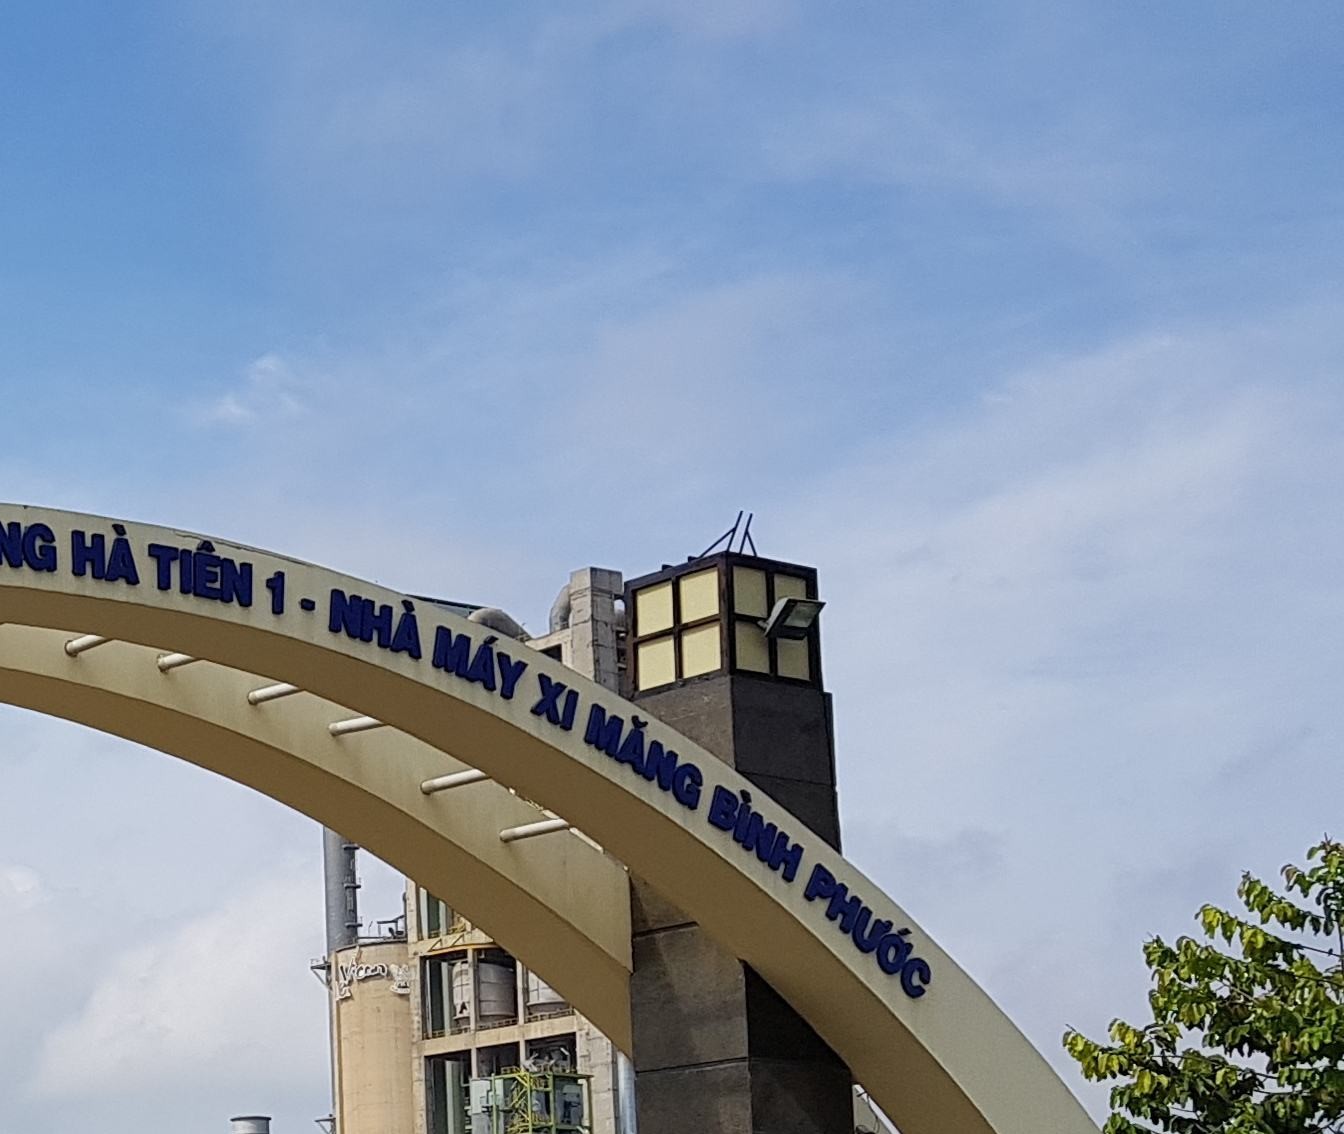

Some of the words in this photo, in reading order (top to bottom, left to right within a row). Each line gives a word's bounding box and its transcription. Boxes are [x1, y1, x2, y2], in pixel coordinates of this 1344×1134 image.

[71, 524, 140, 586] HÀ
[147, 541, 253, 607] TIÊN
[266, 571, 285, 615] 1
[329, 588, 422, 659] NHÀ
[432, 625, 528, 700] MÁY
[530, 673, 580, 732] XI
[584, 703, 704, 810] MĂNG
[707, 784, 805, 883] BÌNH
[804, 862, 933, 1000] PHƯỚC
